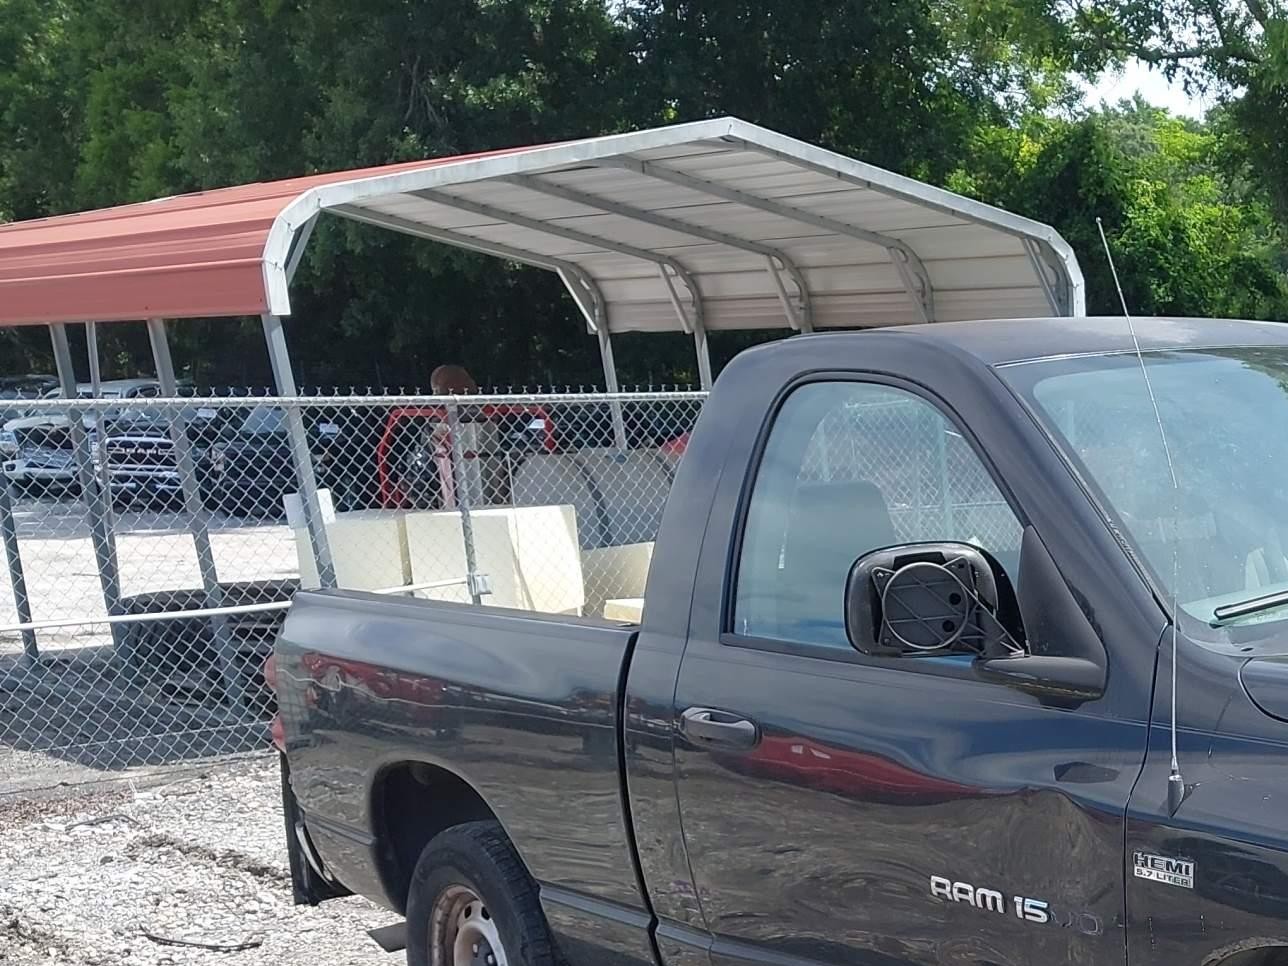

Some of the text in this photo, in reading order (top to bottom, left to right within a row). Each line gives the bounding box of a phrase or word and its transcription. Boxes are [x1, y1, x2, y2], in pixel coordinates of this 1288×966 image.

[1134, 852, 1190, 875] HEMI
[1136, 868, 1190, 887] 5.7 LITER
[930, 875, 1005, 914] RAM
